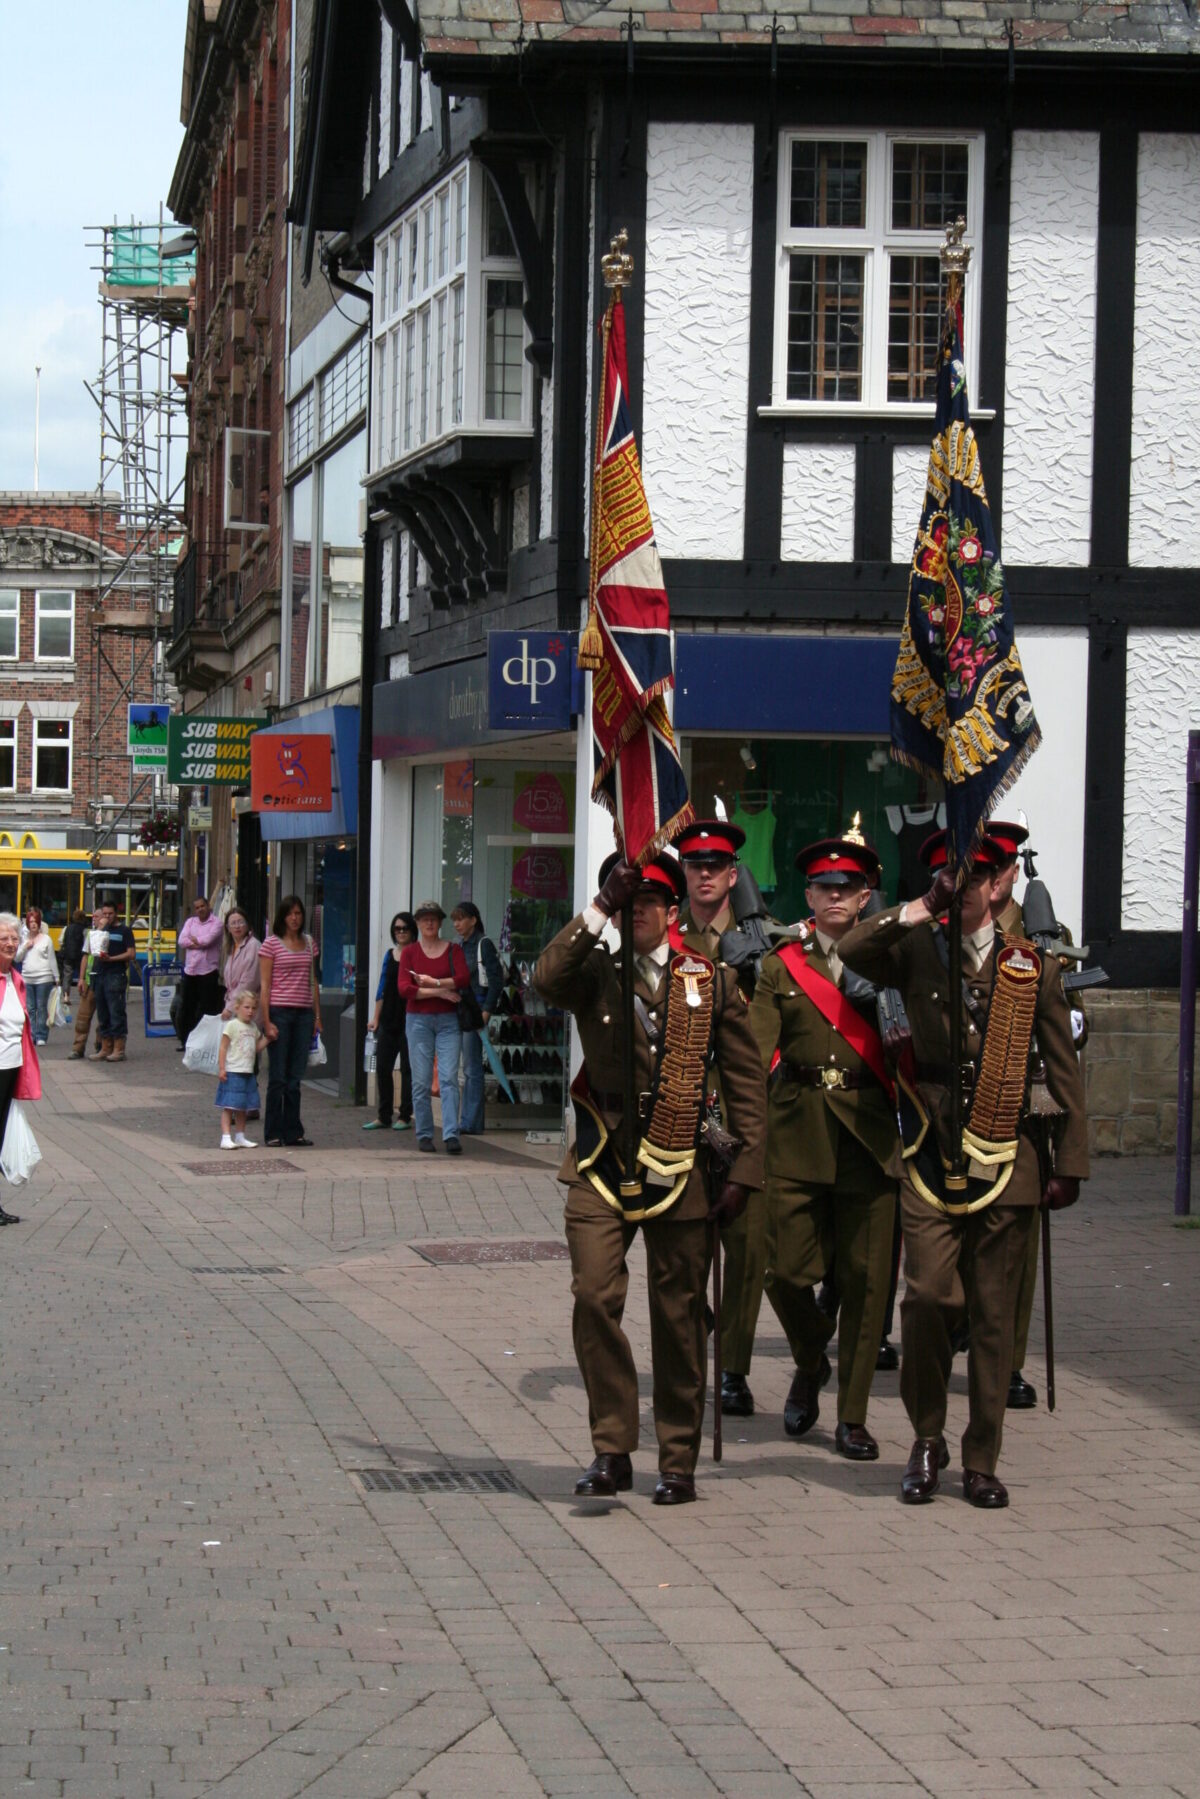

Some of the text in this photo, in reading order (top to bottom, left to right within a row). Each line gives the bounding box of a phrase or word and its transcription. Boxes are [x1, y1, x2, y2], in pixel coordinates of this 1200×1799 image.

[502, 639, 556, 704] dp
[181, 722, 257, 739] SUBWAY
[132, 746, 152, 755] Lloyds
[181, 743, 251, 759] SUBWAY
[137, 765, 155, 774] Lloyds
[180, 763, 252, 780] SUBWAY
